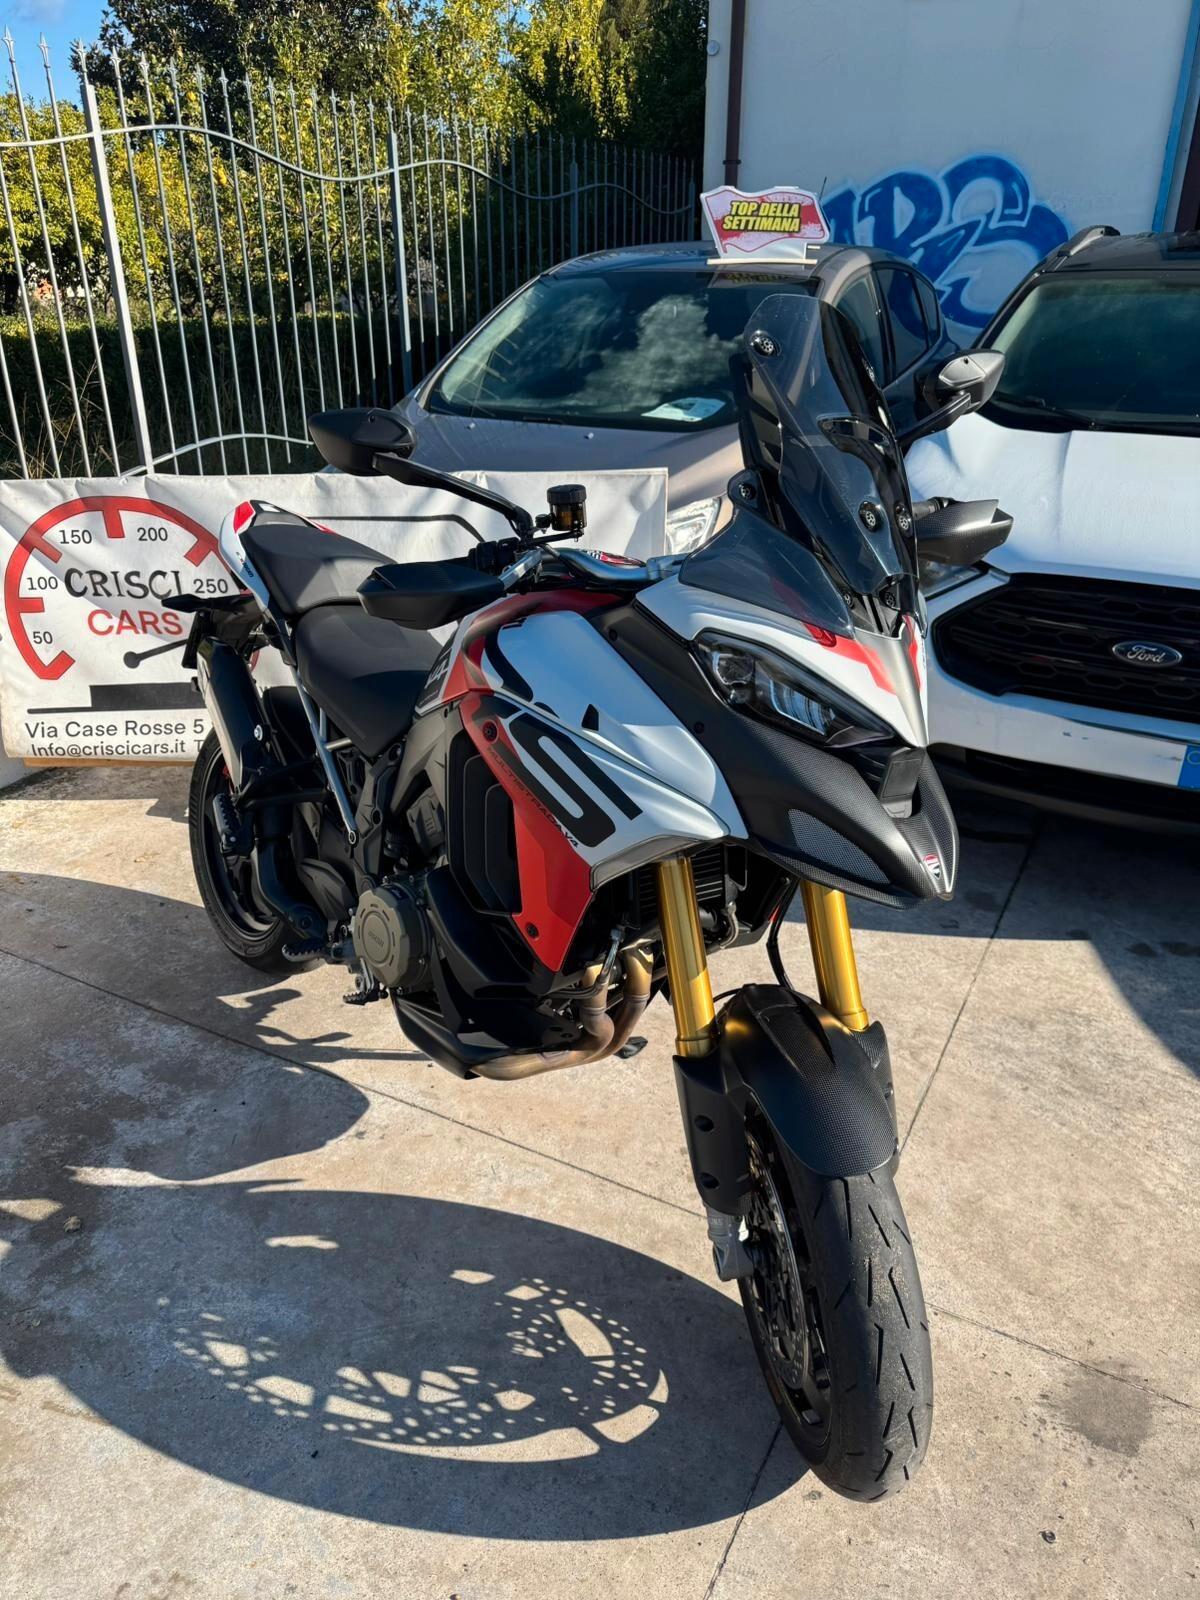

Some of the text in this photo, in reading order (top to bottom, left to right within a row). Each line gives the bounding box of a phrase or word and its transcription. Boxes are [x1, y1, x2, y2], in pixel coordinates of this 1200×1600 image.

[730, 201, 799, 217] TOP DELLA
[723, 216, 800, 232] SETTIMANA
[59, 529, 92, 544] 150
[137, 527, 168, 541] 200
[27, 576, 58, 590] 100
[64, 568, 184, 599] CRISCI
[193, 578, 228, 594] 250
[87, 609, 183, 635] CARS
[33, 631, 53, 645] 50
[1127, 645, 1166, 662] Ford
[25, 719, 204, 738] Via Case Rosse 5
[31, 740, 186, 757] Info@criscicars.it
[563, 831, 579, 848] V4
